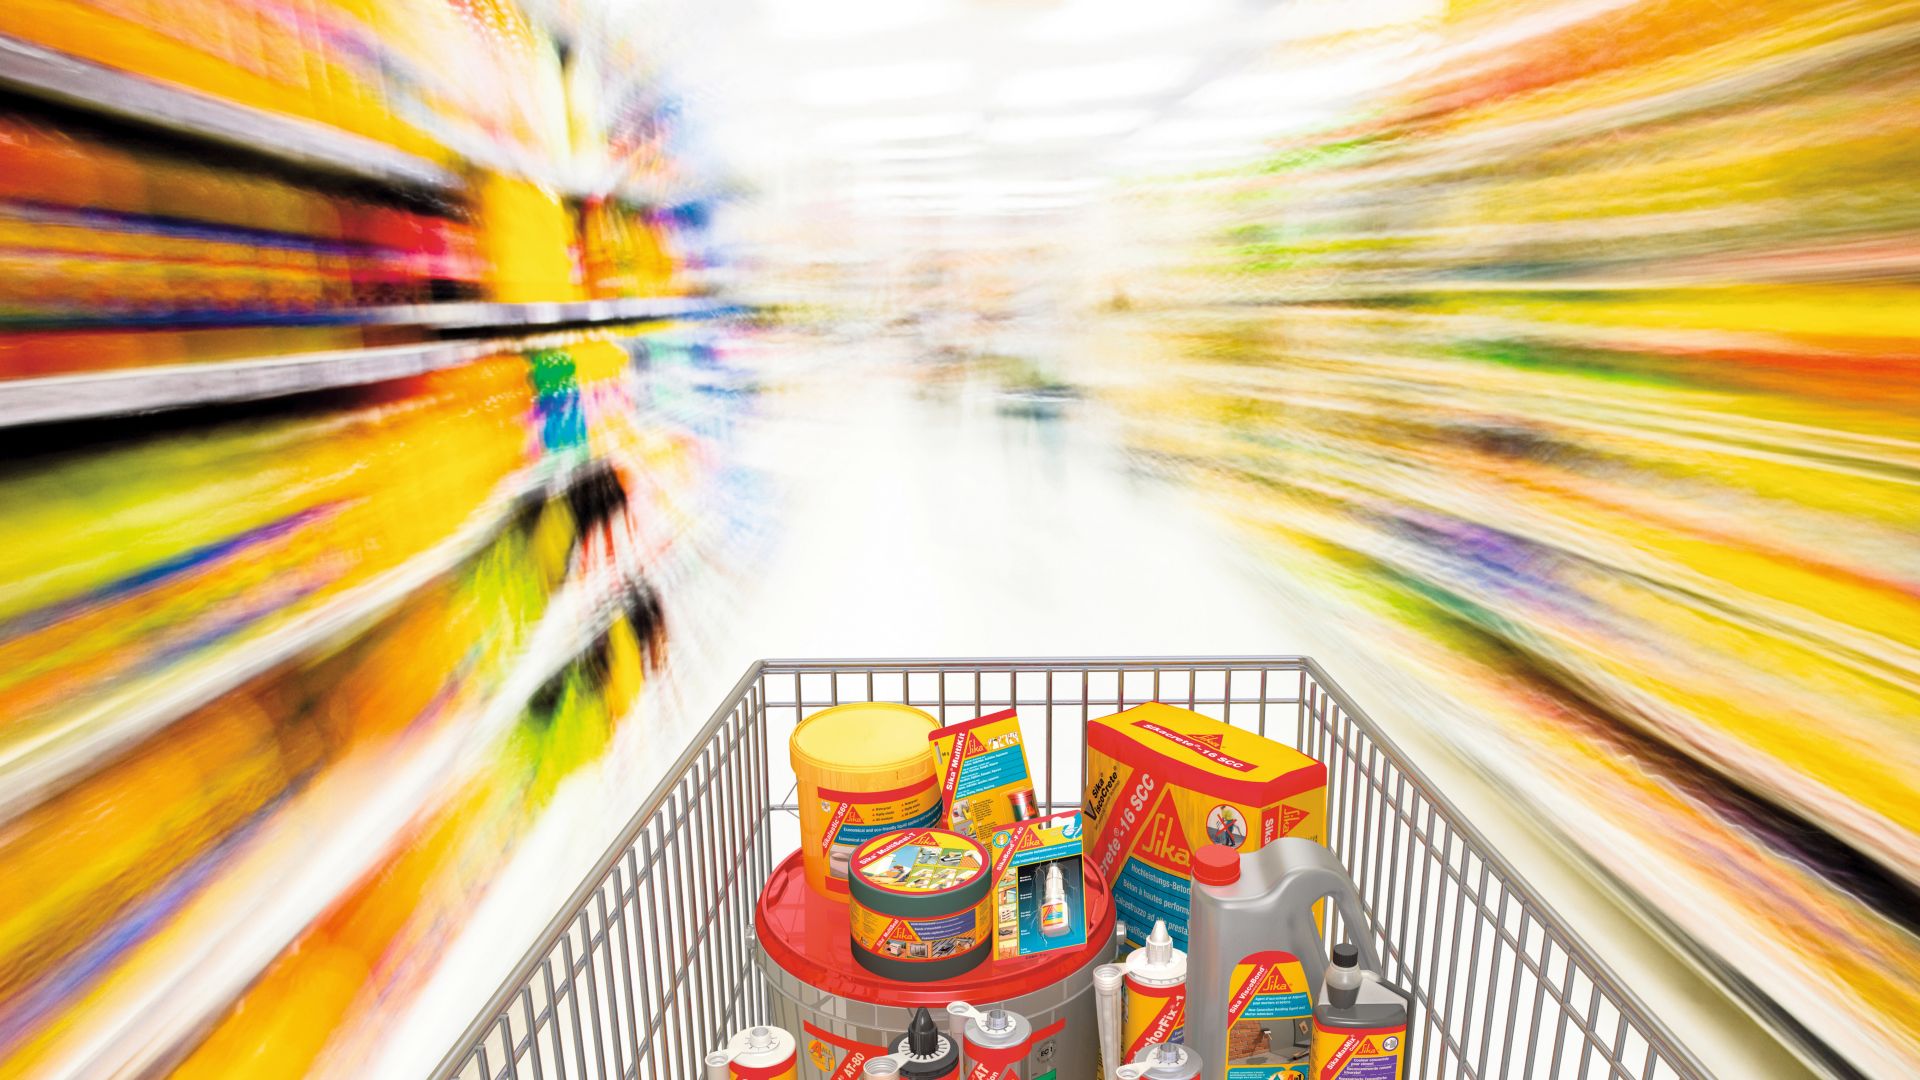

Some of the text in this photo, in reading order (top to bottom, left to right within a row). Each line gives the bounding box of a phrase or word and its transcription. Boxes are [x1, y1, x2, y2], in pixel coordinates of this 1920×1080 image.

[951, 732, 966, 768] MultiKit
[966, 738, 984, 755] Sika
[1217, 756, 1244, 768] SCC
[1130, 773, 1155, 812] SCC
[1282, 807, 1300, 834] Sika
[1264, 817, 1274, 844] Sika
[914, 836, 937, 845] Sika
[1021, 833, 1040, 848] Sika
[1141, 812, 1191, 868] Sika
[1123, 878, 1138, 893] Béton
[1143, 890, 1163, 905] hautes
[1115, 893, 1147, 918] Calcestruzzo
[1147, 912, 1155, 921] ad
[893, 927, 913, 940] Sika
[1263, 975, 1287, 991] Sika
[1229, 1000, 1242, 1014] Sika
[1358, 1044, 1376, 1054] Sika
[843, 1052, 865, 1078] AT-80
[1326, 1058, 1339, 1070] Sika
